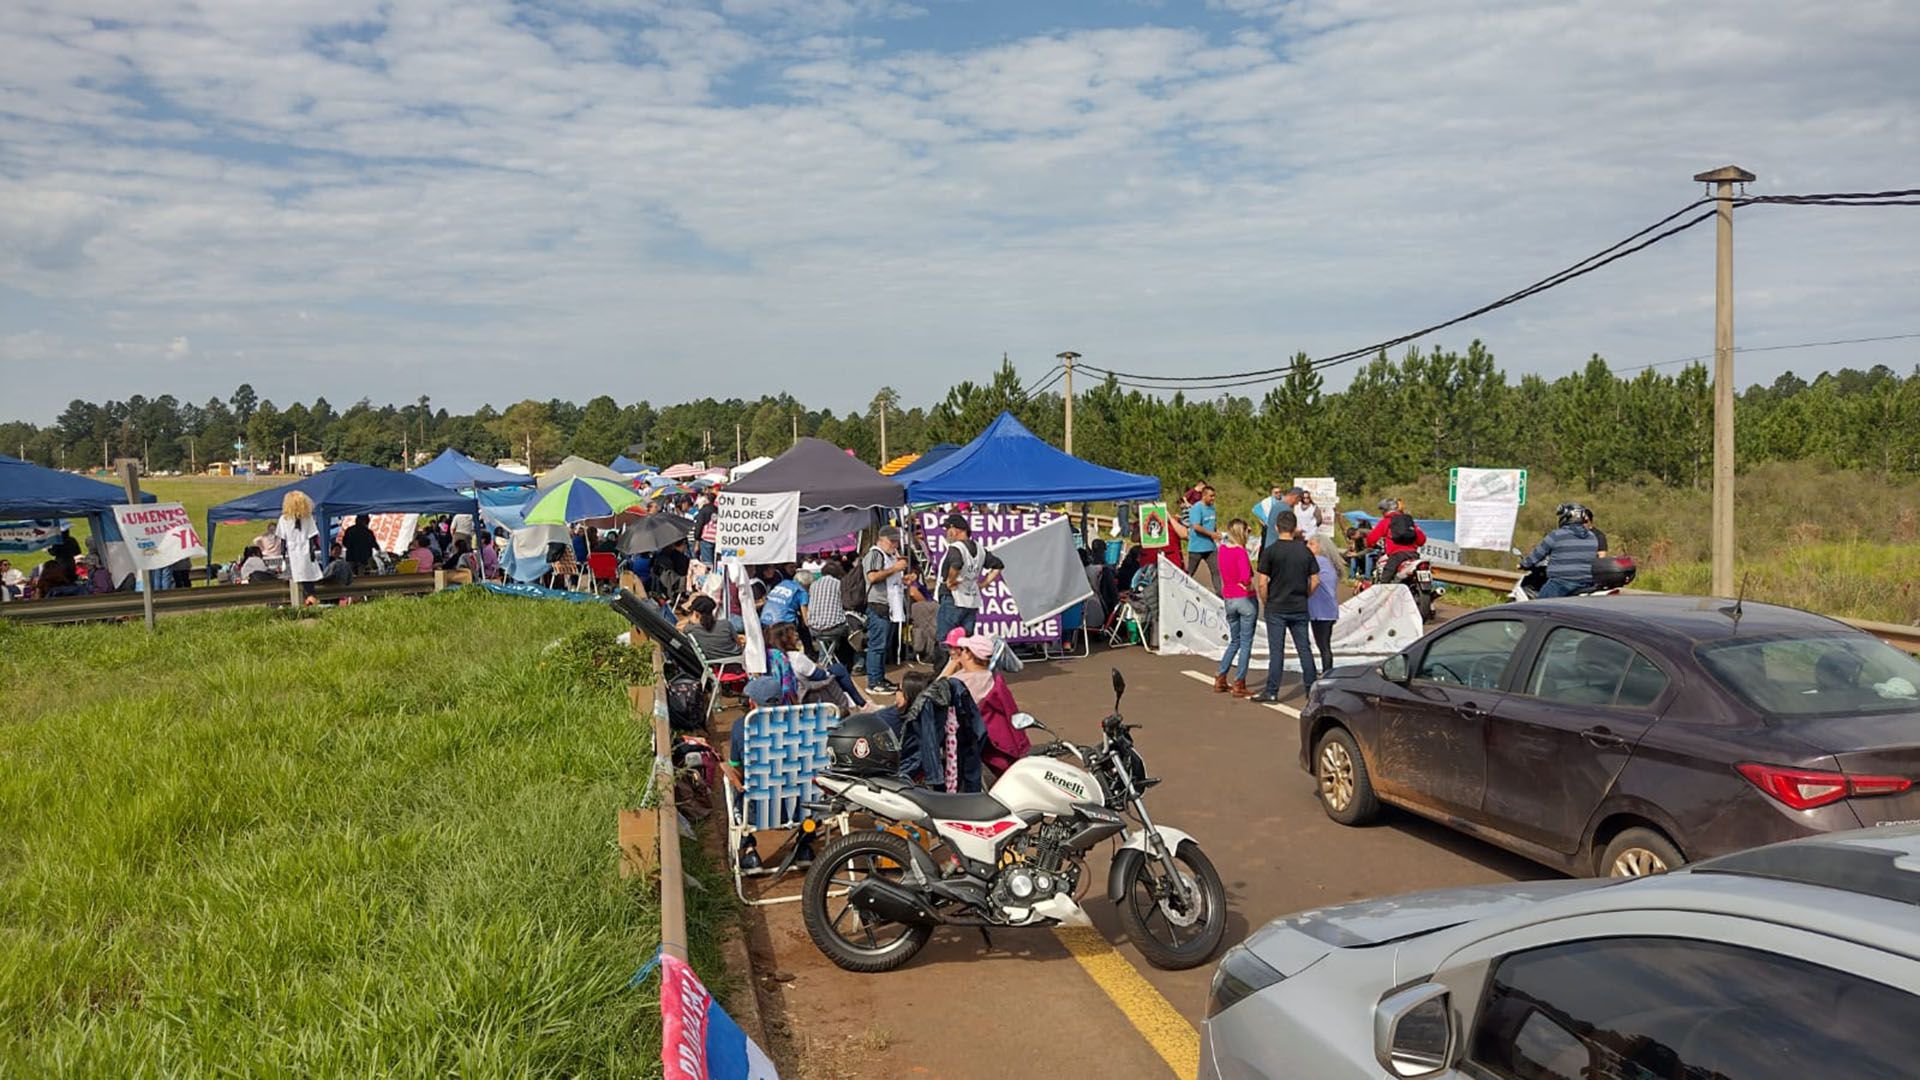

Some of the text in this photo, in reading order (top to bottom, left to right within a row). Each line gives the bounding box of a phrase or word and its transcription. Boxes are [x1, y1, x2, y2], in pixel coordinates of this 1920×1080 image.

[741, 496, 758, 507] DE
[122, 507, 186, 525] UMENTO
[923, 512, 1051, 533] DENTES
[172, 528, 206, 549] YA
[721, 536, 766, 546] SIONES
[1044, 770, 1086, 796] Benelli
